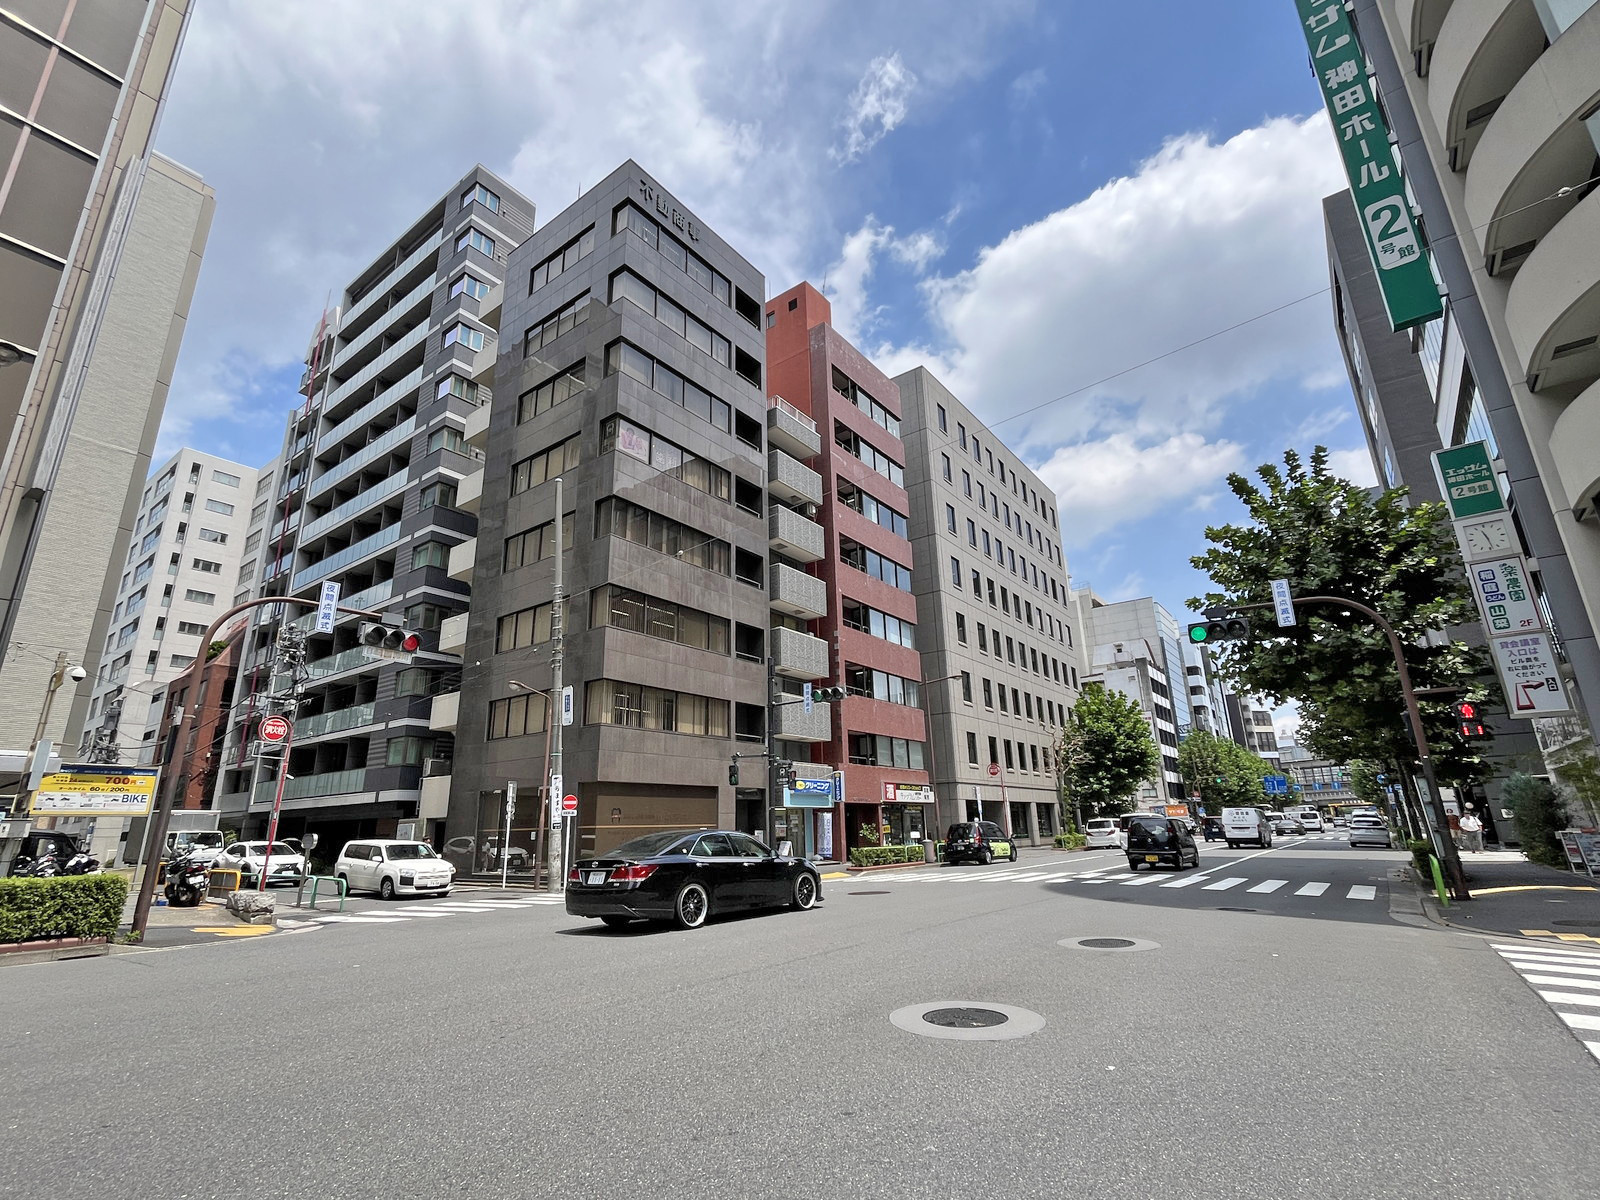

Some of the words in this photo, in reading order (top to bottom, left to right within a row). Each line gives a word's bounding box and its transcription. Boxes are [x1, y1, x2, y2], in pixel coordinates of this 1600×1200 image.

[1305, 0, 1390, 188] サム神田ホール
[1371, 203, 1408, 242] 2
[1381, 243, 1415, 258] 号館
[1445, 462, 1488, 477] エッサム
[1447, 470, 1490, 483] 神田ホール
[1455, 483, 1489, 497] 2号館
[320, 584, 336, 630] 夜間点滅式
[1276, 582, 1291, 623] 夜間点滅式
[1520, 619, 1533, 627] 2F
[1508, 648, 1539, 657] 入口は
[1507, 663, 1547, 672] 右に曲がって
[1547, 678, 1558, 690] 入口
[886, 784, 895, 799] 酒
[121, 795, 148, 803] BIKE
